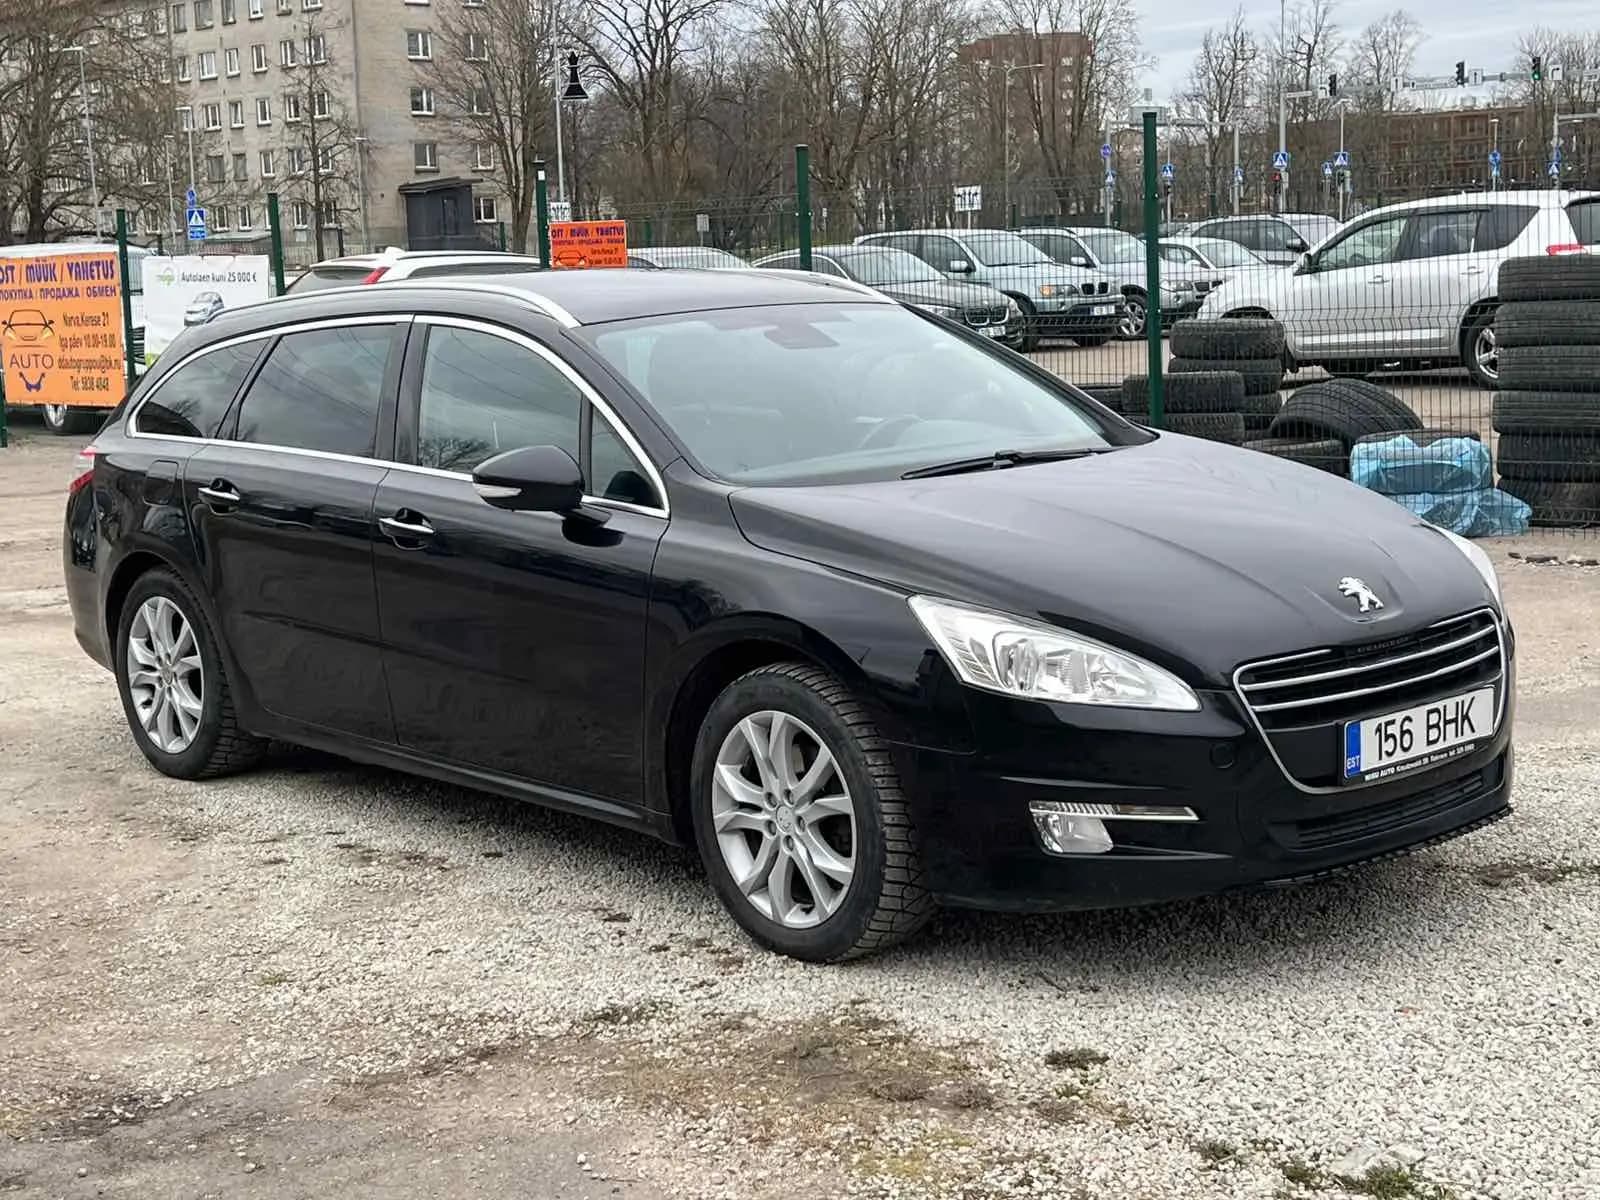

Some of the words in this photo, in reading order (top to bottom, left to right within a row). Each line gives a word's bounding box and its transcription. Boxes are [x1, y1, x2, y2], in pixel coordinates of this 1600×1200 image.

[25, 257, 57, 282] MÜÜK
[181, 271, 210, 282] Autolaen
[211, 271, 226, 282] kuni
[40, 287, 80, 300] ПРОДАЖА
[86, 285, 117, 298] ОБМЕН
[10, 354, 54, 369] AUTO
[1374, 715, 1413, 761] 156
[1426, 696, 1476, 746] BHK
[1346, 755, 1360, 769] EST
